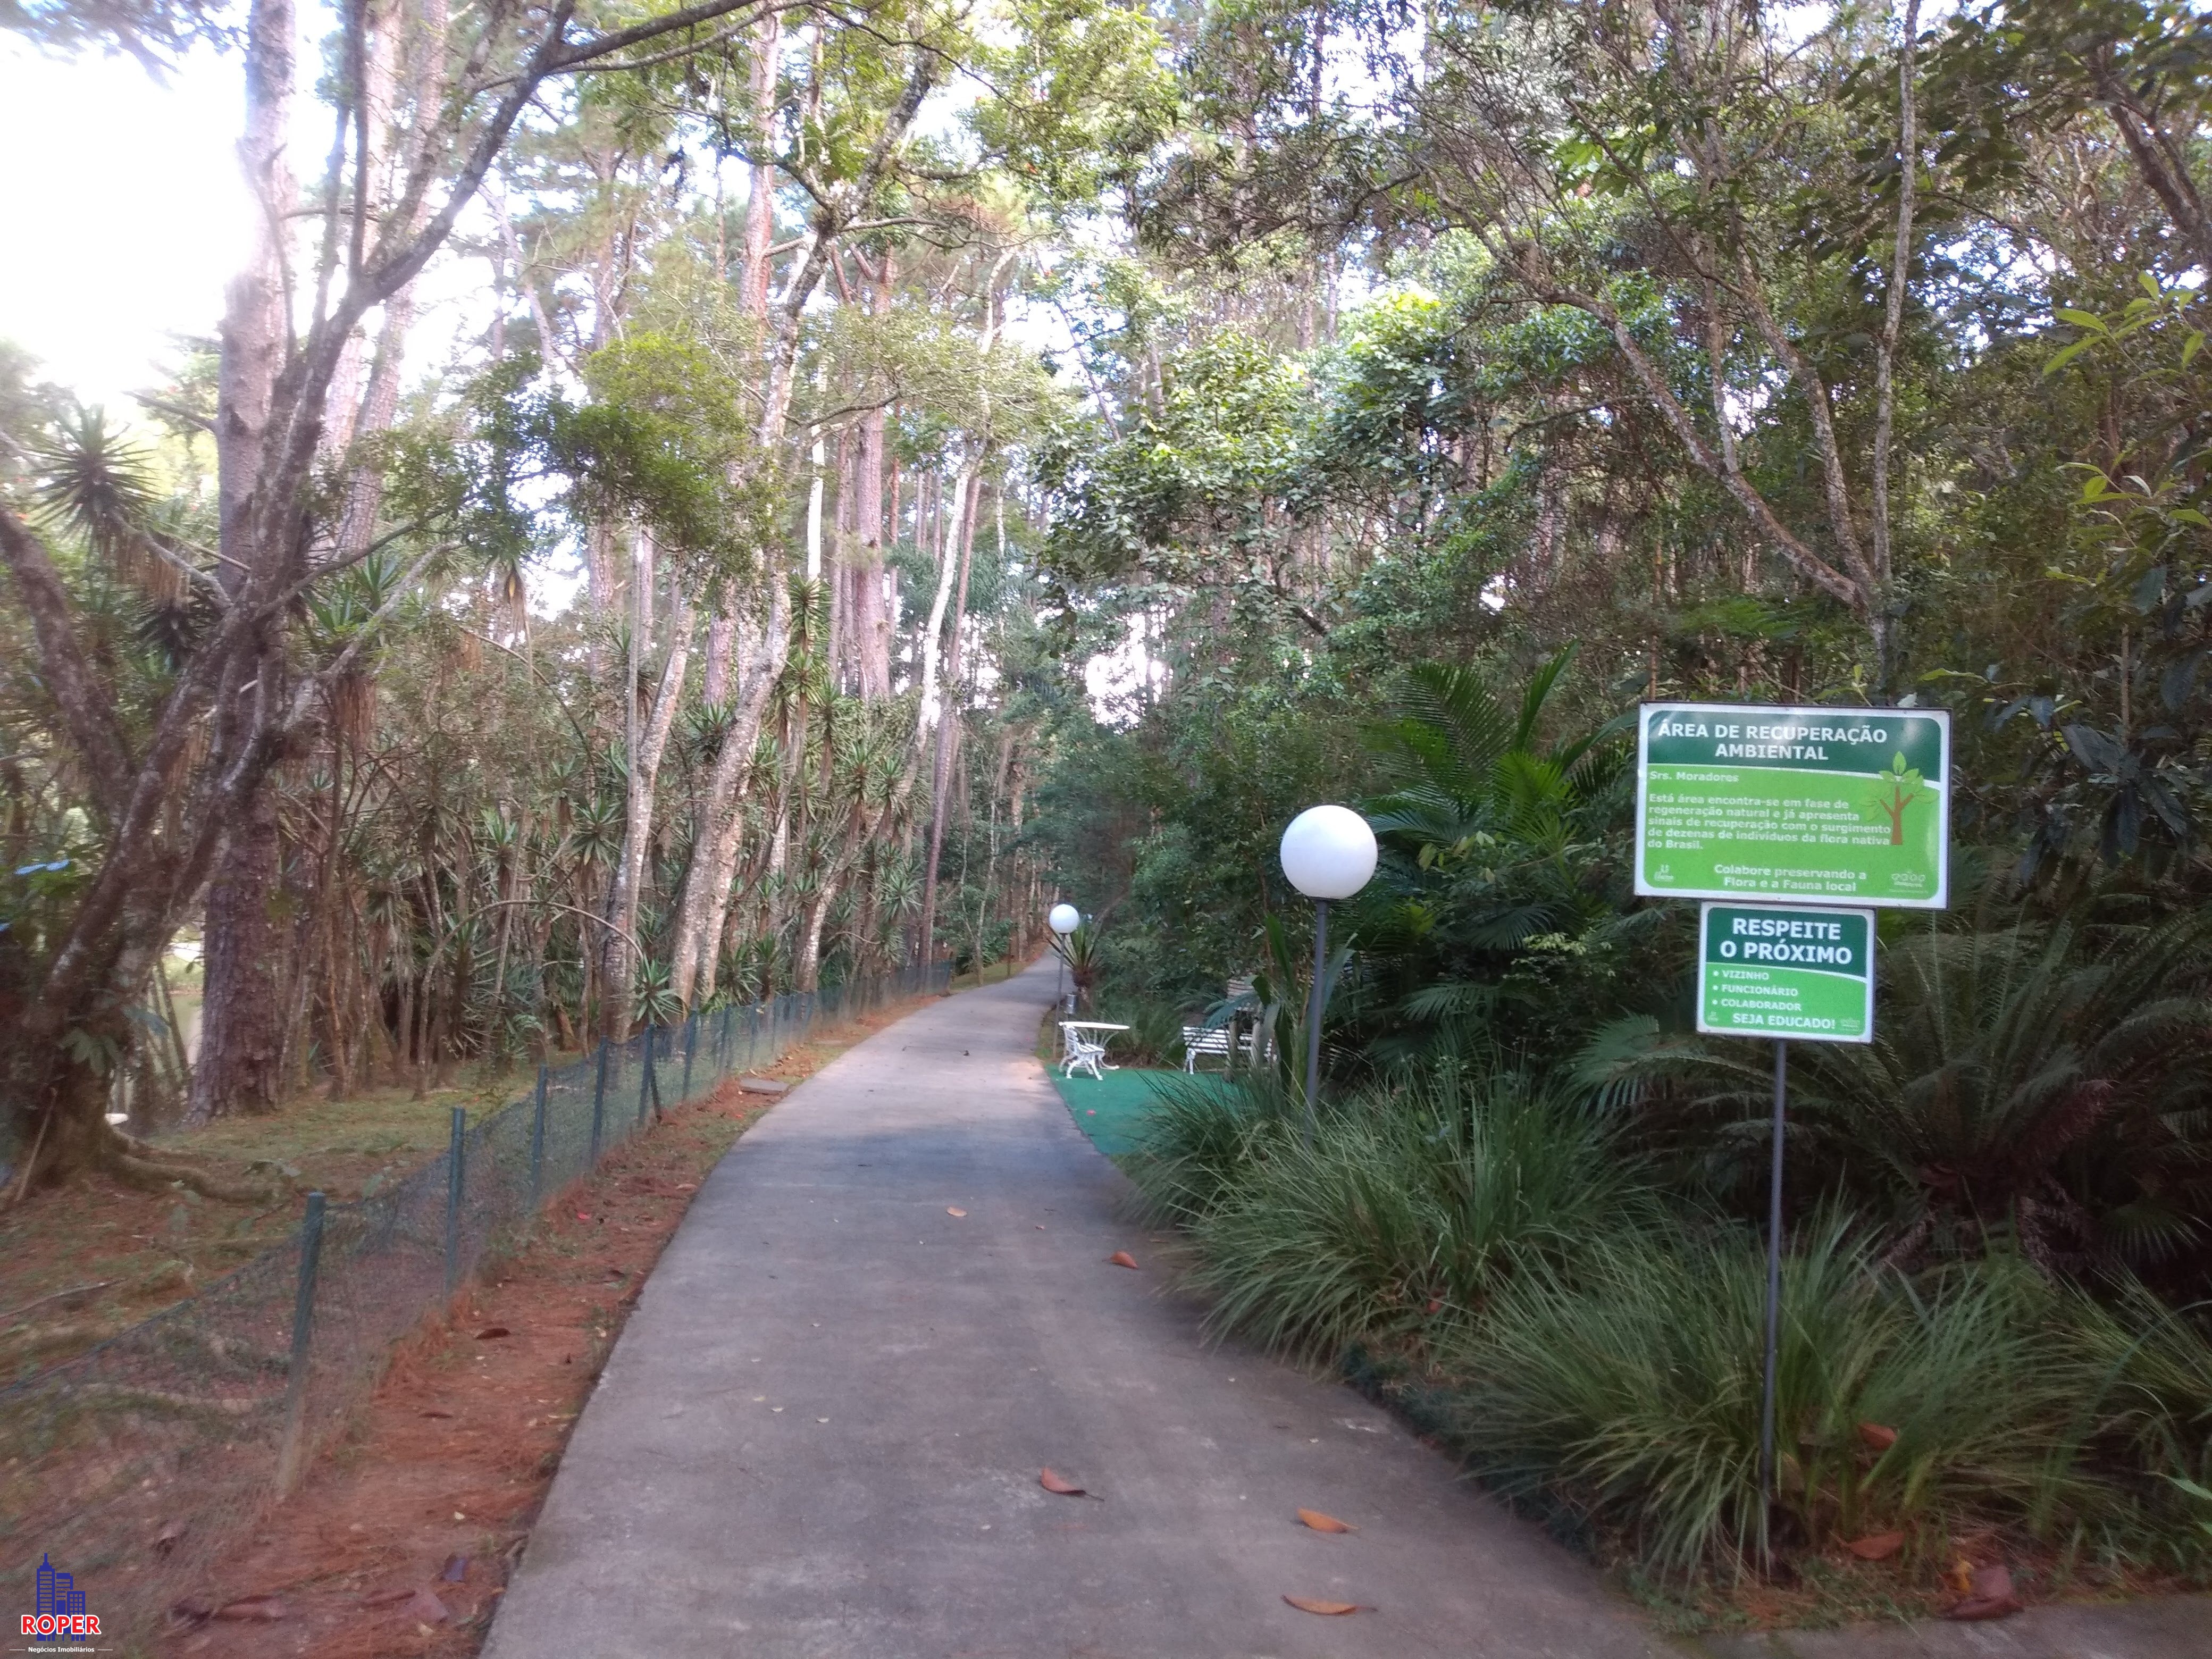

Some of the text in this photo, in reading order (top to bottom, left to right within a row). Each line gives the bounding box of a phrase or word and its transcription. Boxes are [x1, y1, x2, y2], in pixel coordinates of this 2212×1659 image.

[1658, 719, 1887, 744] ÁREA DE RECUPERAÇÃO
[1715, 743, 1829, 760] AMBIENTAL
[1650, 770, 1739, 782] Srs. Moradores
[1649, 793, 1674, 803] Está
[1677, 794, 1704, 803] área
[1708, 797, 1780, 807] encontra-se
[1805, 798, 1830, 808] fase
[1833, 800, 1849, 809] de
[1649, 806, 1723, 817] regeneração
[1727, 808, 1770, 817] natural
[1783, 809, 1795, 820] já
[1799, 811, 1860, 821] apresenta
[1648, 817, 1683, 825] sinais
[1686, 817, 1701, 826] de
[1704, 819, 1778, 830] recuperação
[1781, 822, 1807, 831] com
[1821, 824, 1891, 834] surgimento
[1648, 827, 1889, 845] de dezenas de indivíduos da flora nativa
[1648, 839, 1703, 850] do Brasil.
[1714, 864, 1867, 880] Colabore preservando a
[1724, 877, 1756, 887] Flora
[1759, 879, 1768, 888] e
[1783, 879, 1822, 890] Fauna
[1825, 881, 1856, 892] local
[1732, 918, 1841, 940] RESPEITE
[1720, 939, 1852, 965] O PRÓXIMO
[1721, 969, 1770, 981] VIZINHO
[1721, 984, 1799, 996] FUNCIONÁRIO
[1720, 999, 1802, 1011] COLABORADOR
[1732, 1013, 1764, 1025] SEJA
[1767, 1015, 1836, 1030] EDUCADO!
